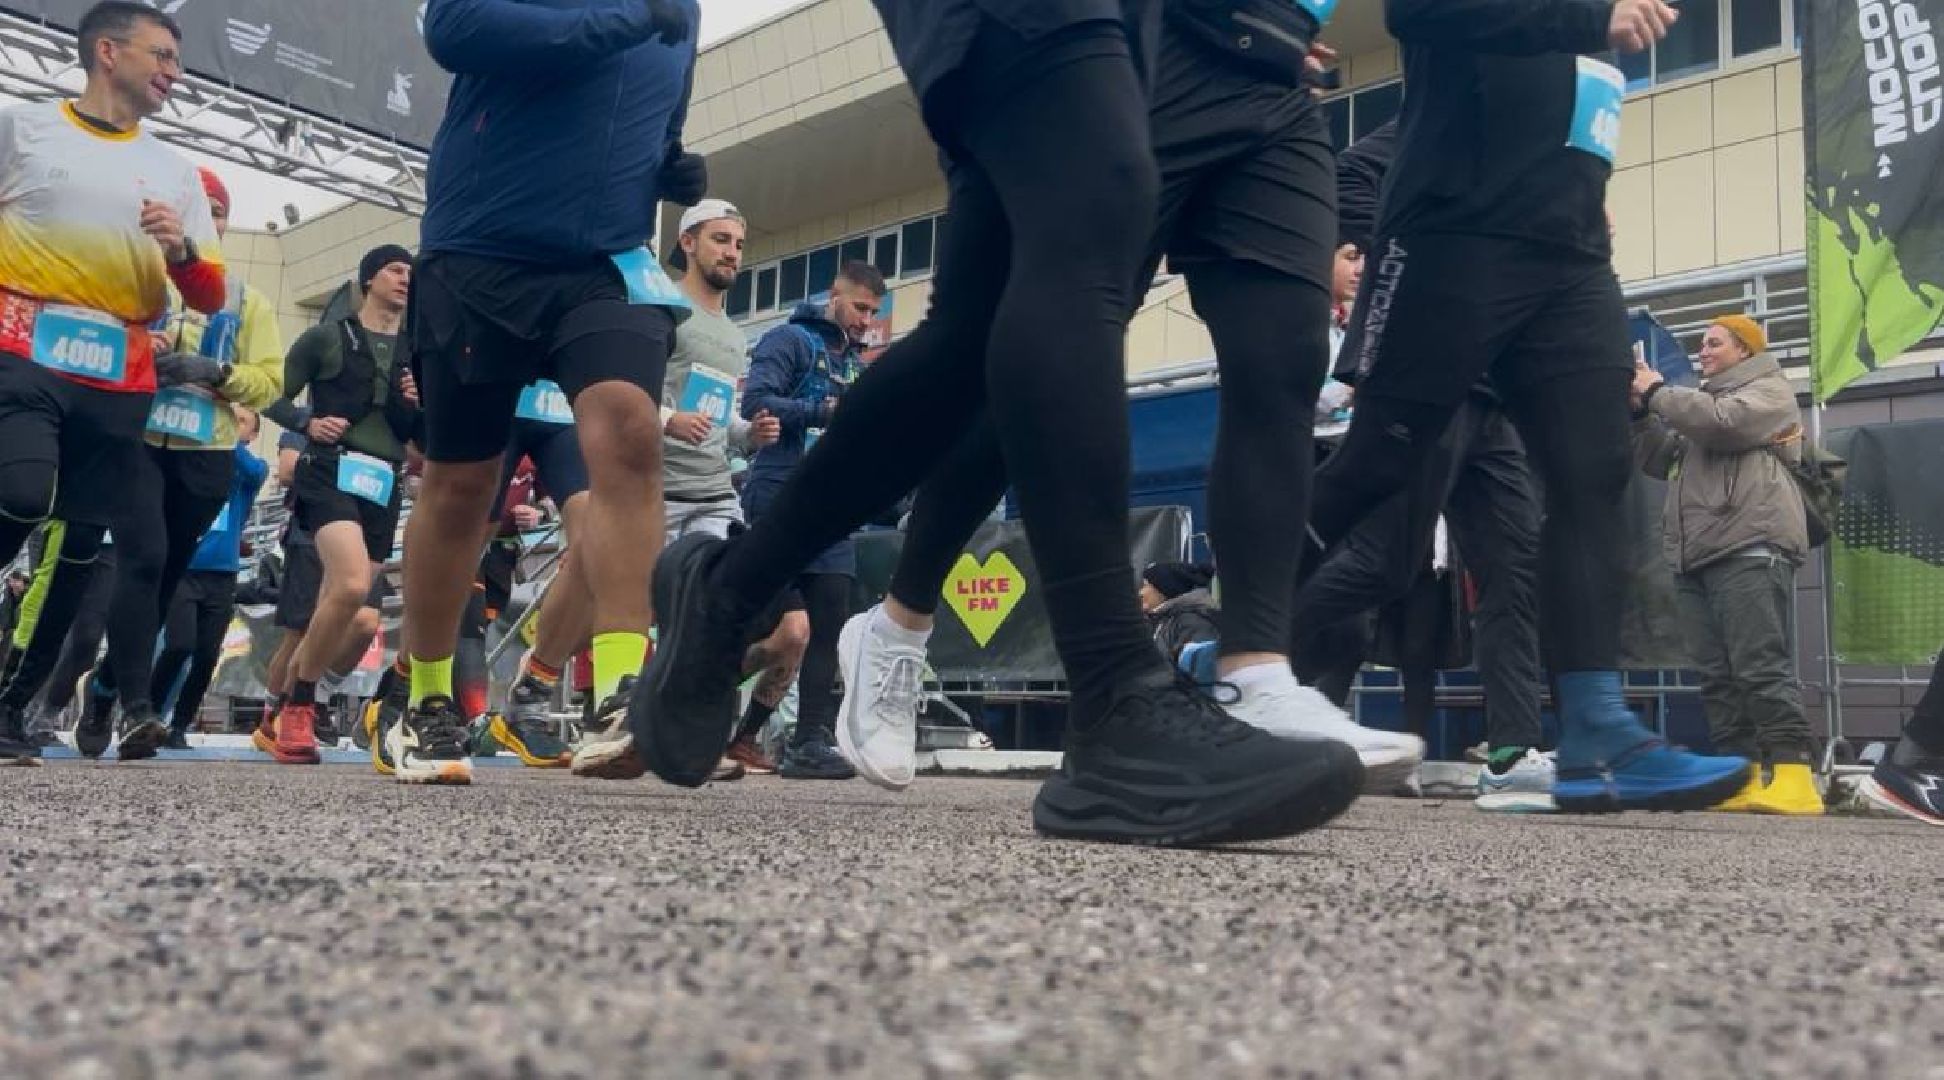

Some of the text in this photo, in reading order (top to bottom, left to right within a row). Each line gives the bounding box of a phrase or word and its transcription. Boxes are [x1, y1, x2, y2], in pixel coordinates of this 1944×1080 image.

[1857, 0, 1907, 147] МОСО
[1889, 0, 1942, 133] СПОР
[956, 577, 1010, 595] LIKE
[967, 597, 999, 612] FM
